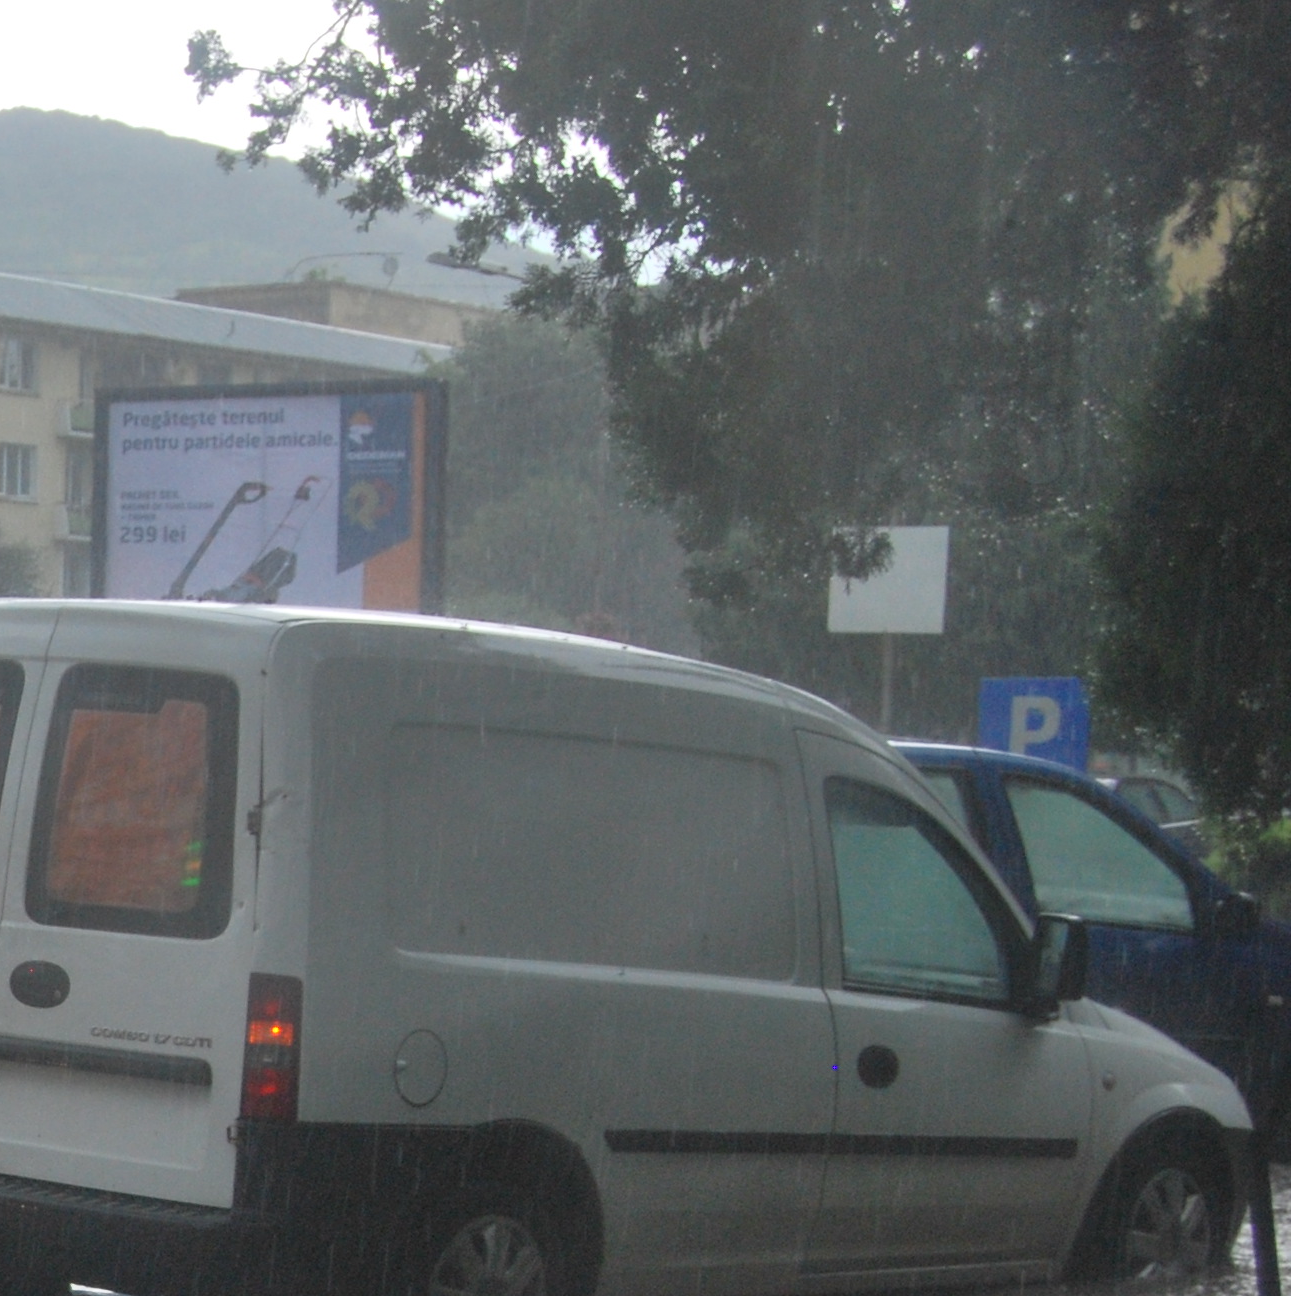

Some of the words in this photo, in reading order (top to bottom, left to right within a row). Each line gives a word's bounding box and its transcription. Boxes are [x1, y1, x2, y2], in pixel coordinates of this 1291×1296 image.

[221, 408, 286, 427] terenul
[122, 435, 180, 455] pentru
[184, 432, 261, 452] partidele
[265, 430, 338, 448] amicale.
[119, 526, 157, 544] 299
[163, 525, 187, 543] lei
[1008, 695, 1061, 754] P
[90, 1026, 150, 1043] COMBO
[172, 1035, 214, 1049] CDTI
